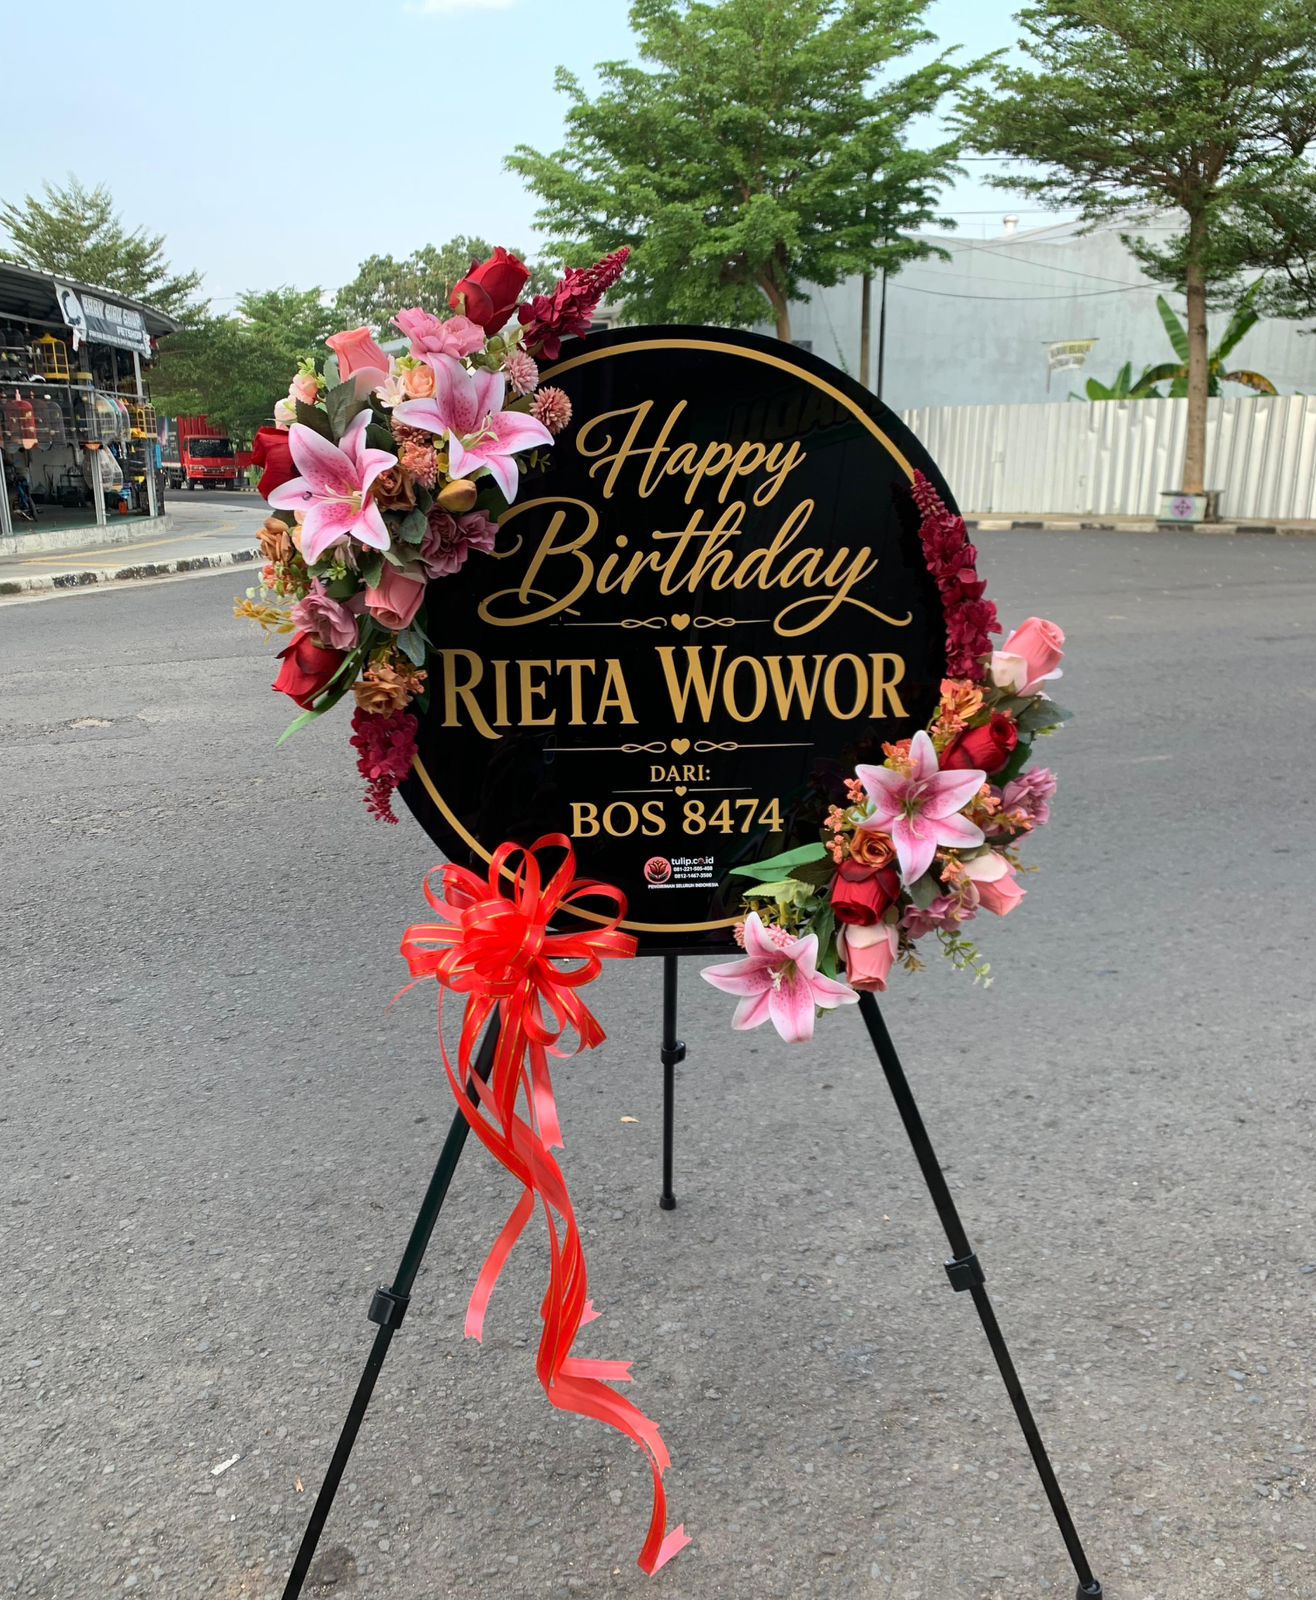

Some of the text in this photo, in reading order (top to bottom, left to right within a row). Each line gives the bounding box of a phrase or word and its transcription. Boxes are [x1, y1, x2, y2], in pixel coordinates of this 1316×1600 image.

[576, 399, 806, 507] Happy
[478, 496, 912, 638] Birthday
[442, 645, 910, 740] RIETA WOWOR
[650, 764, 710, 783] DARI:
[570, 798, 784, 839] BOS 8474
[671, 856, 714, 866] tulip.co.id
